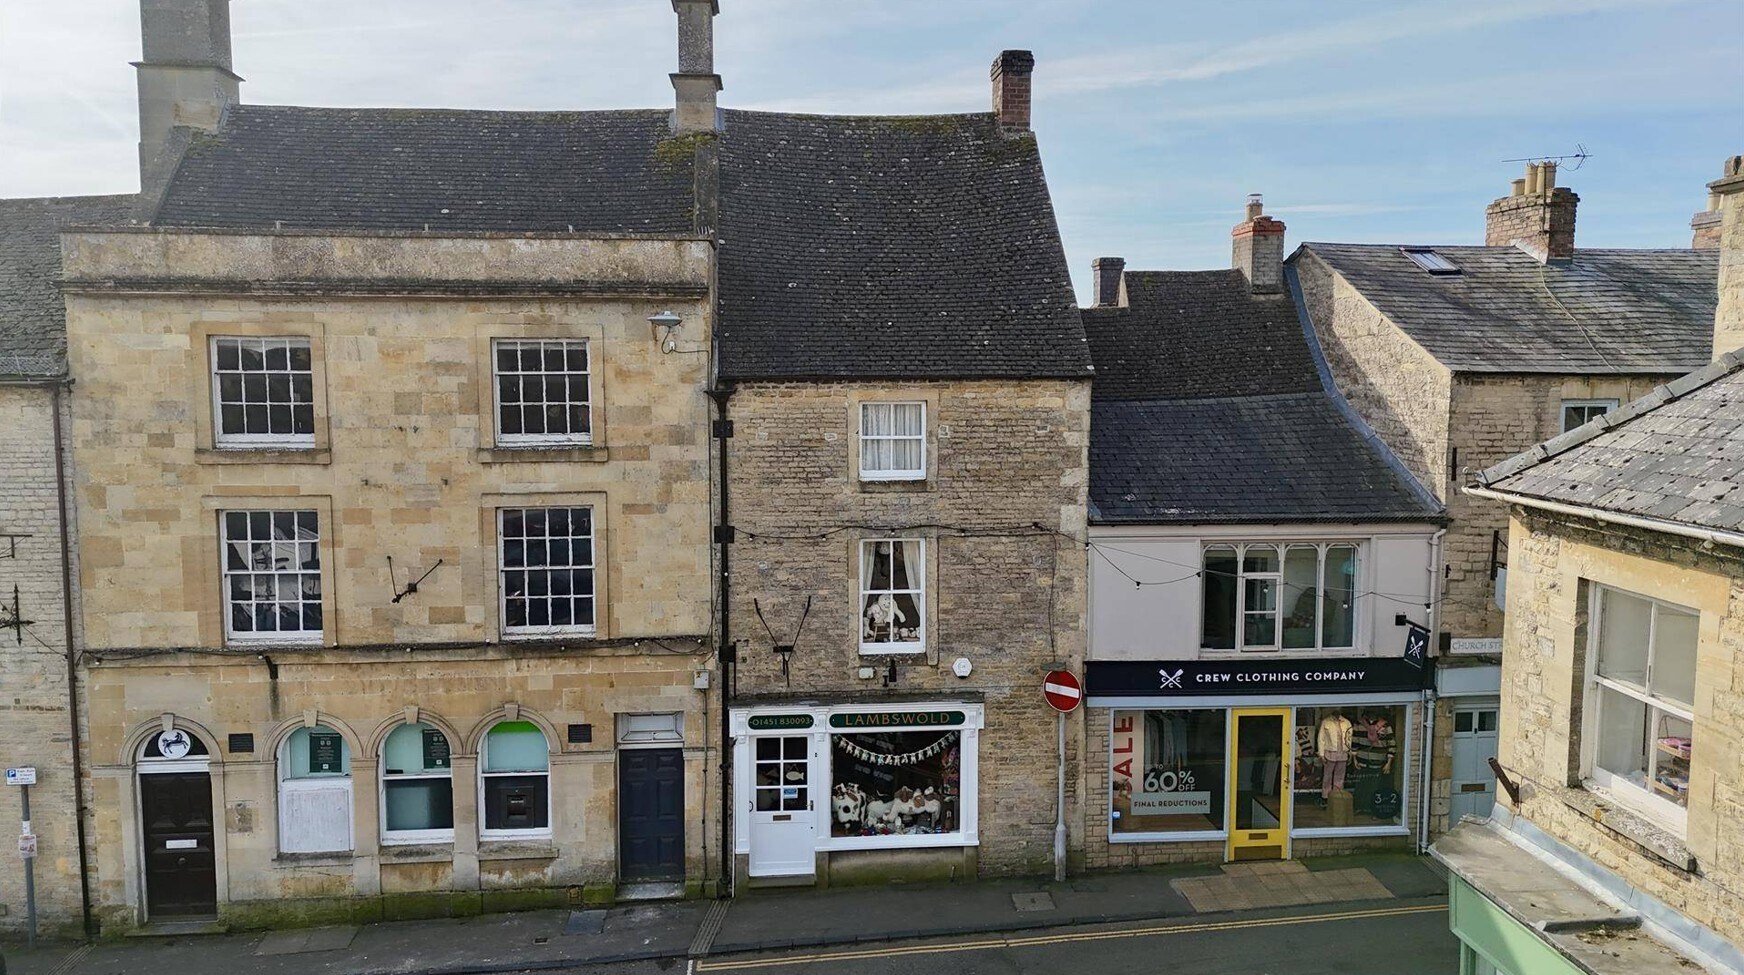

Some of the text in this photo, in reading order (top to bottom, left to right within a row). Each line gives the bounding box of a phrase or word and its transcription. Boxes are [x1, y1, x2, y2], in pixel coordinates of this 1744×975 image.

[1452, 642, 1486, 651] CHURCH
[1196, 671, 1366, 683] CREW CLOTHING COMPANY
[780, 717, 810, 725] 830093
[845, 712, 951, 726] LAMBSWOLD
[1178, 784, 1196, 792] OFF
[1133, 799, 1208, 808] FINAL REDUCTIONS
